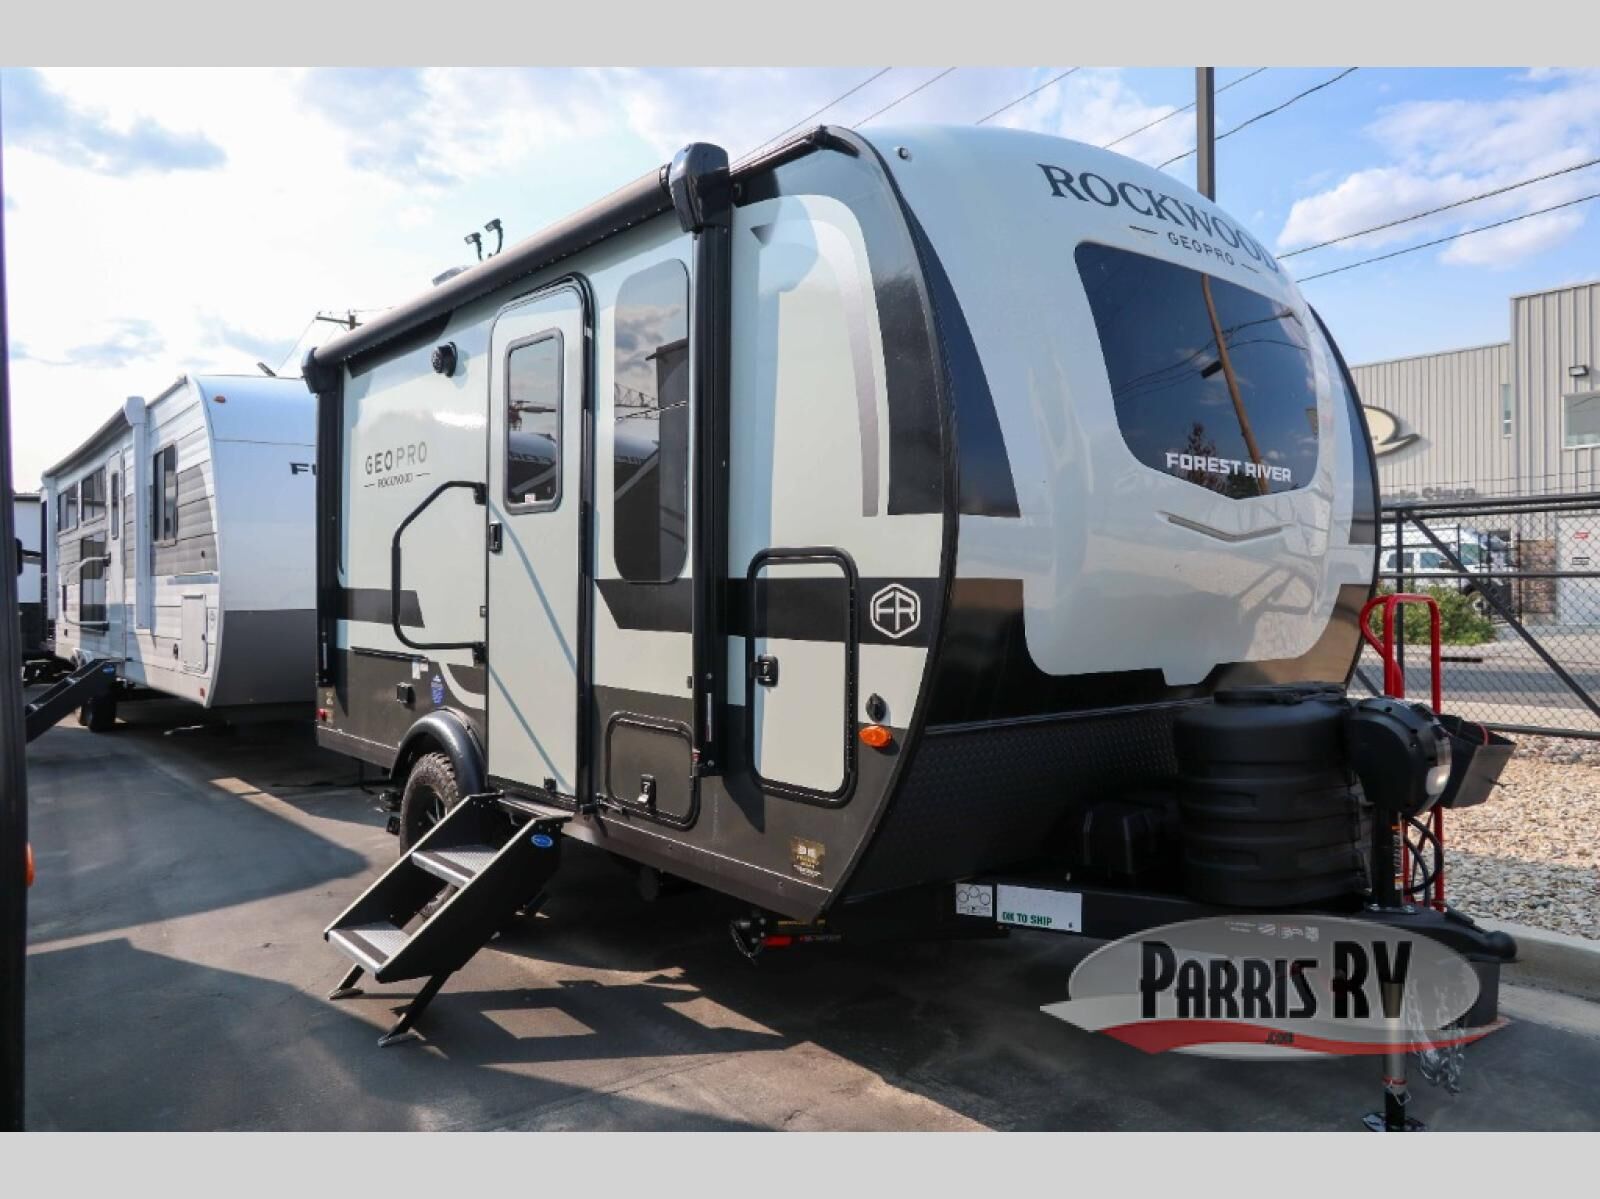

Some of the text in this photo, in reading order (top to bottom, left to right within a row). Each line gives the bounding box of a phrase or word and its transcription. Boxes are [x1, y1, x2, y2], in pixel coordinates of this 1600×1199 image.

[1037, 163, 1279, 273] ROCKWOOD
[1168, 231, 1234, 266] GEOPRO
[365, 441, 427, 475] GEOPRO
[1165, 452, 1292, 482] FOREST RIVER
[1016, 912, 1028, 924] TO
[1030, 914, 1053, 926] SHIP
